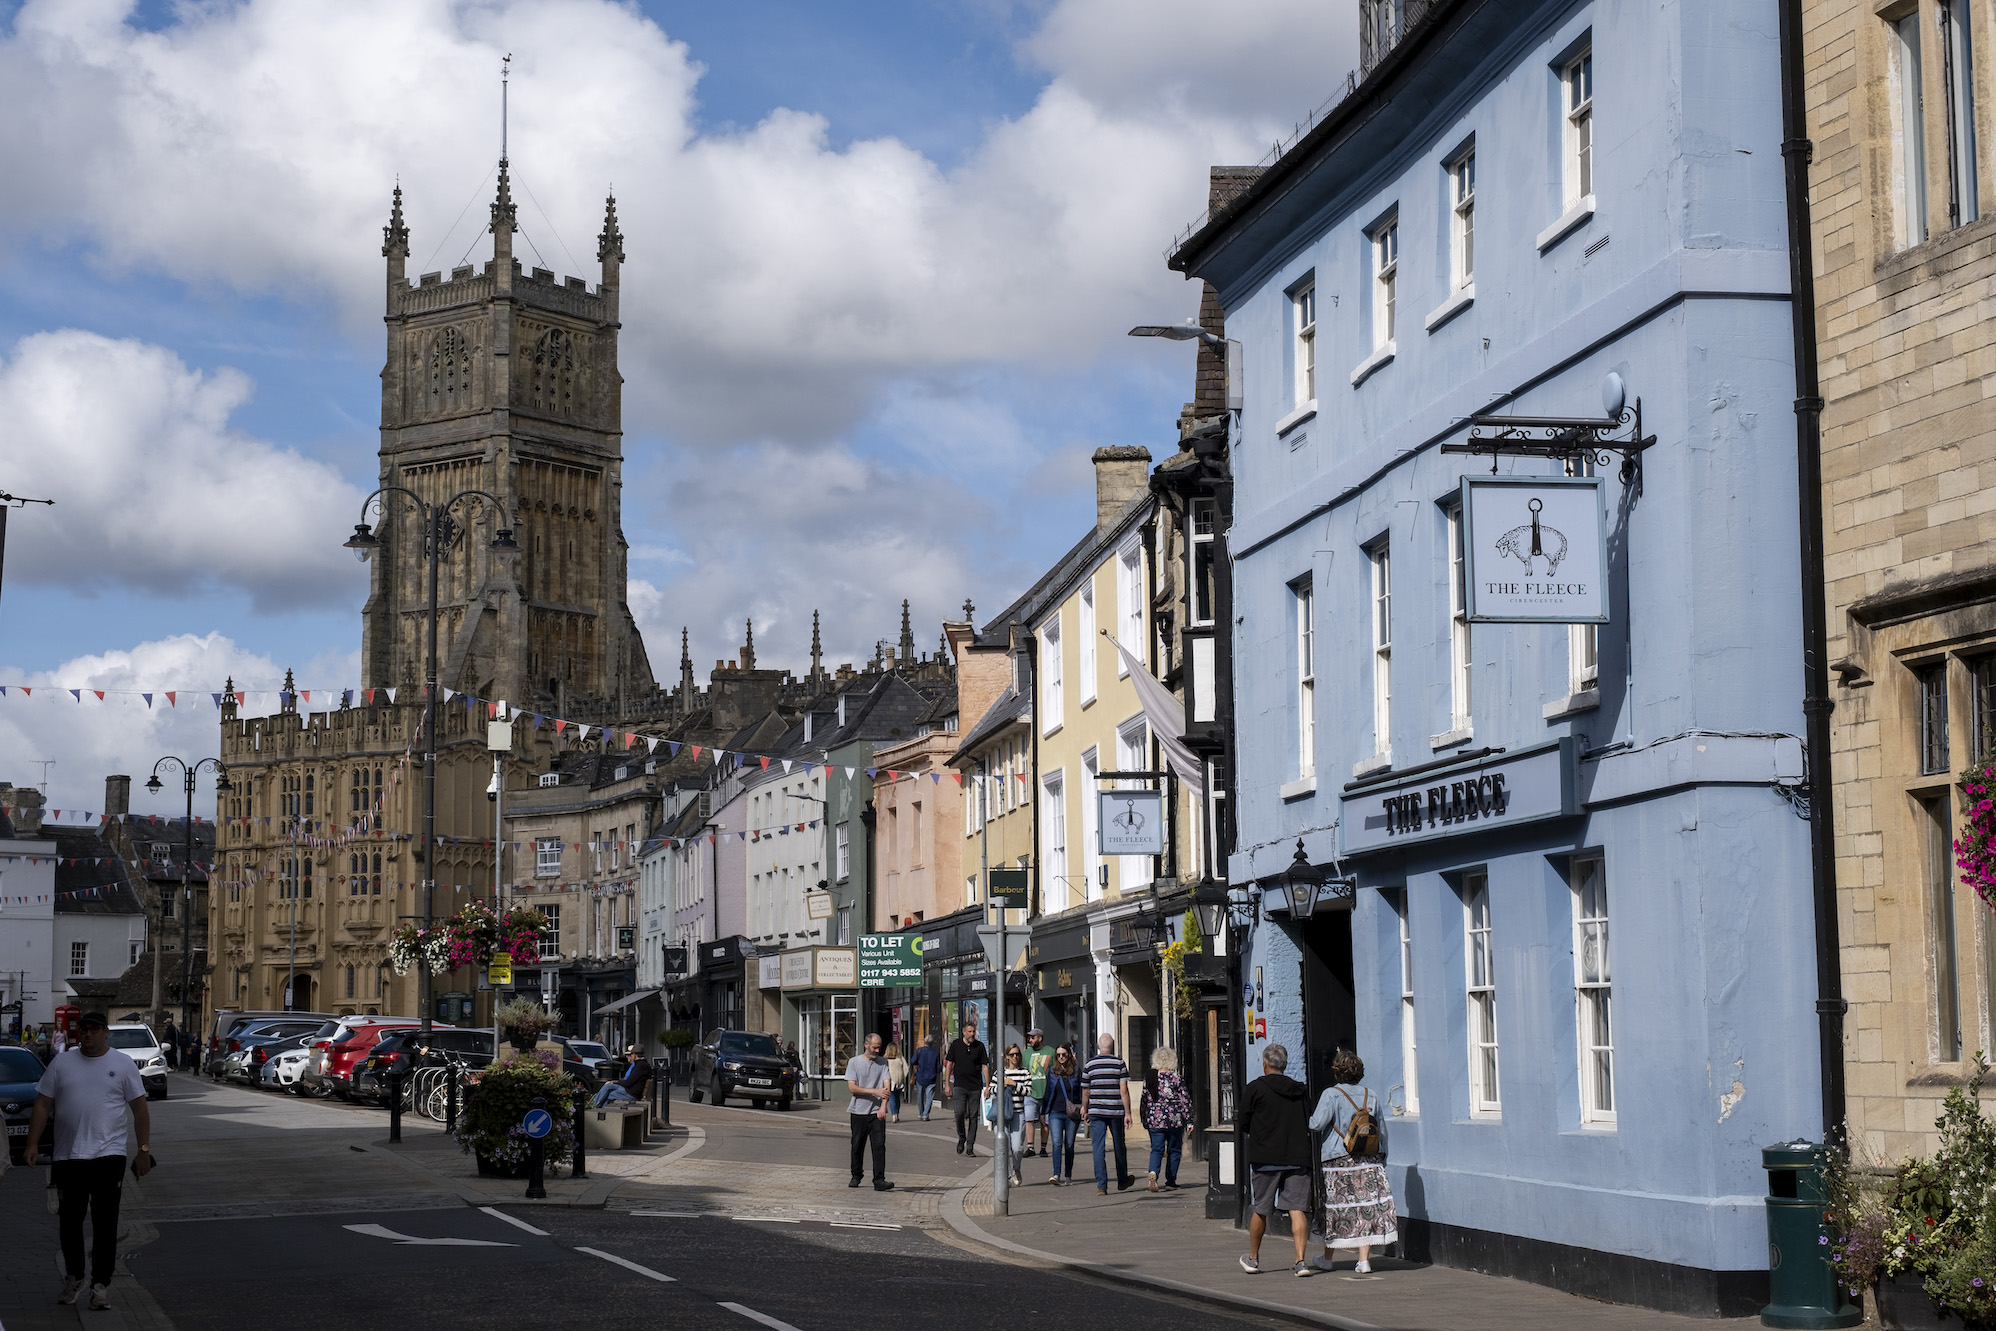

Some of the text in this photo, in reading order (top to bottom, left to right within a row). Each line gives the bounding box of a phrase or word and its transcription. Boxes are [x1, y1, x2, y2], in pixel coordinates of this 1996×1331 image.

[1486, 583, 1587, 595] THE FLEECE
[1383, 773, 1505, 832] THE FLEECE
[860, 936, 904, 948] TO LET
[861, 968, 921, 977] 0117 943 5852
